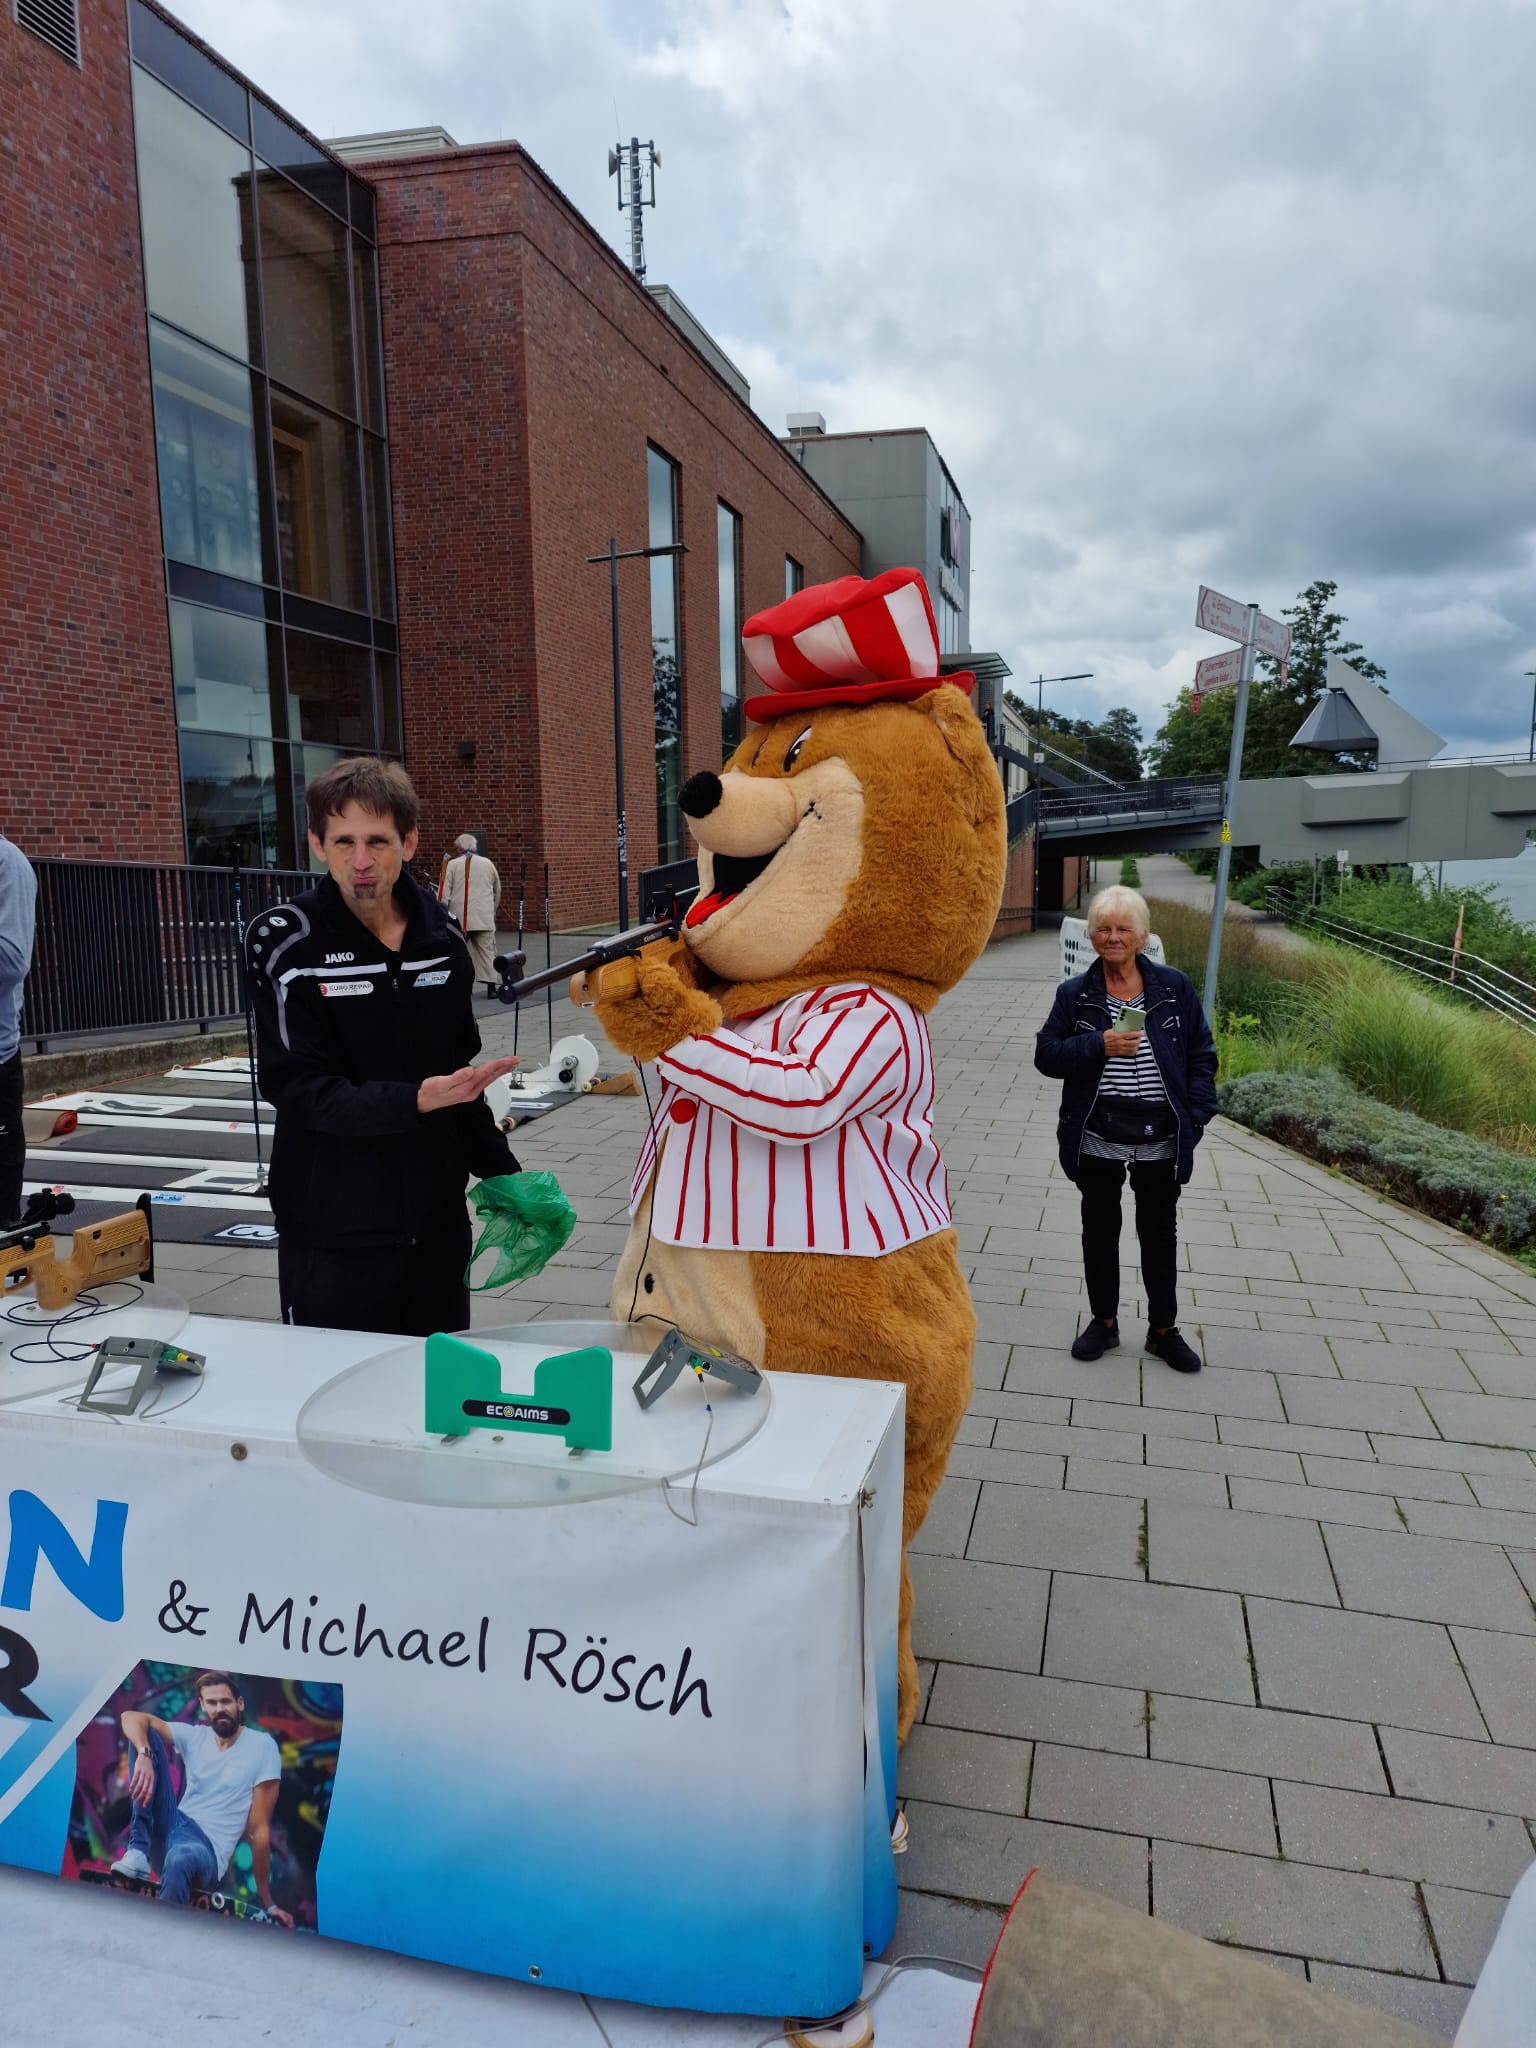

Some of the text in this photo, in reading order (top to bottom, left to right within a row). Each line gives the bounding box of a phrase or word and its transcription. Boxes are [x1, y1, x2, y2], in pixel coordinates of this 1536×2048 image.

[324, 951, 355, 964] JAKO
[158, 1579, 713, 1718] & Michael Rösch
